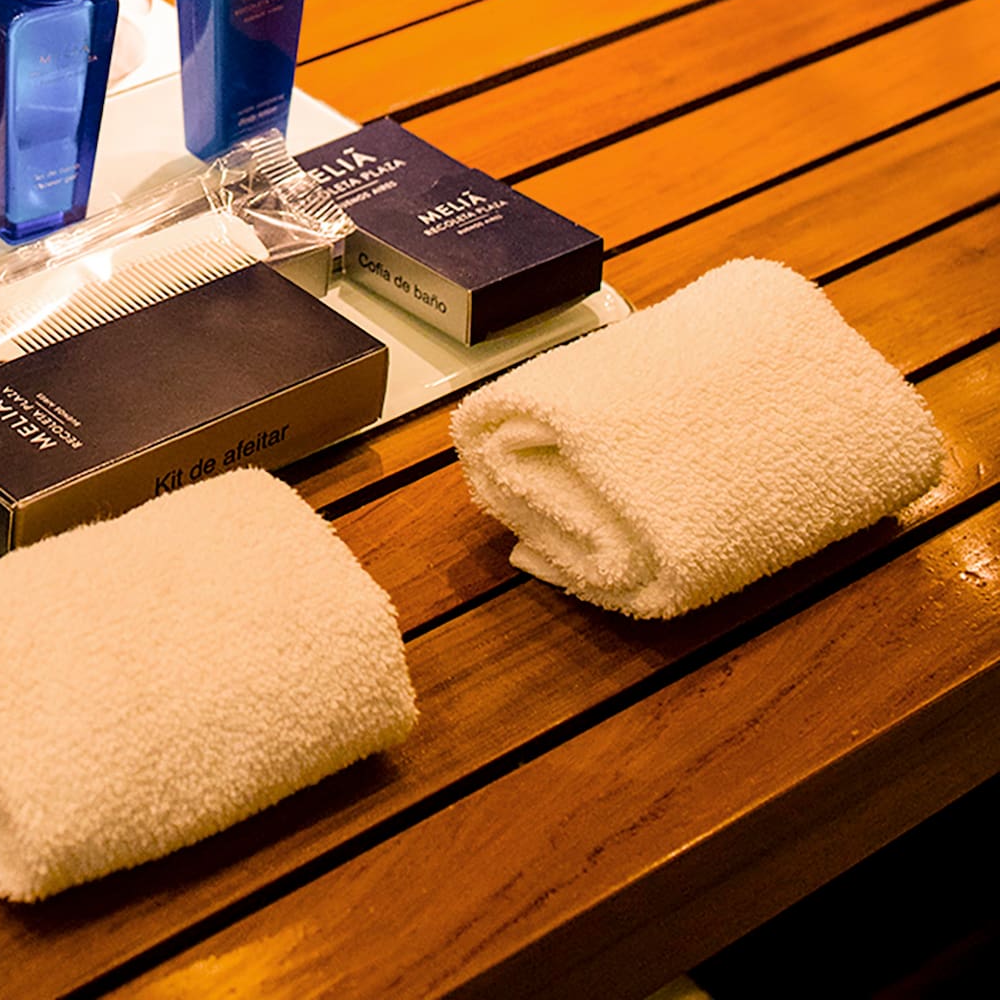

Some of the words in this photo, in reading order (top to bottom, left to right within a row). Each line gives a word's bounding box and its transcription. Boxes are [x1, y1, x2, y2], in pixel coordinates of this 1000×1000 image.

[358, 252, 391, 282] Cofia
[393, 276, 411, 294] de
[413, 284, 448, 314] baño
[155, 467, 184, 496] Kit
[189, 458, 217, 481] de
[223, 424, 289, 467] afeitar
